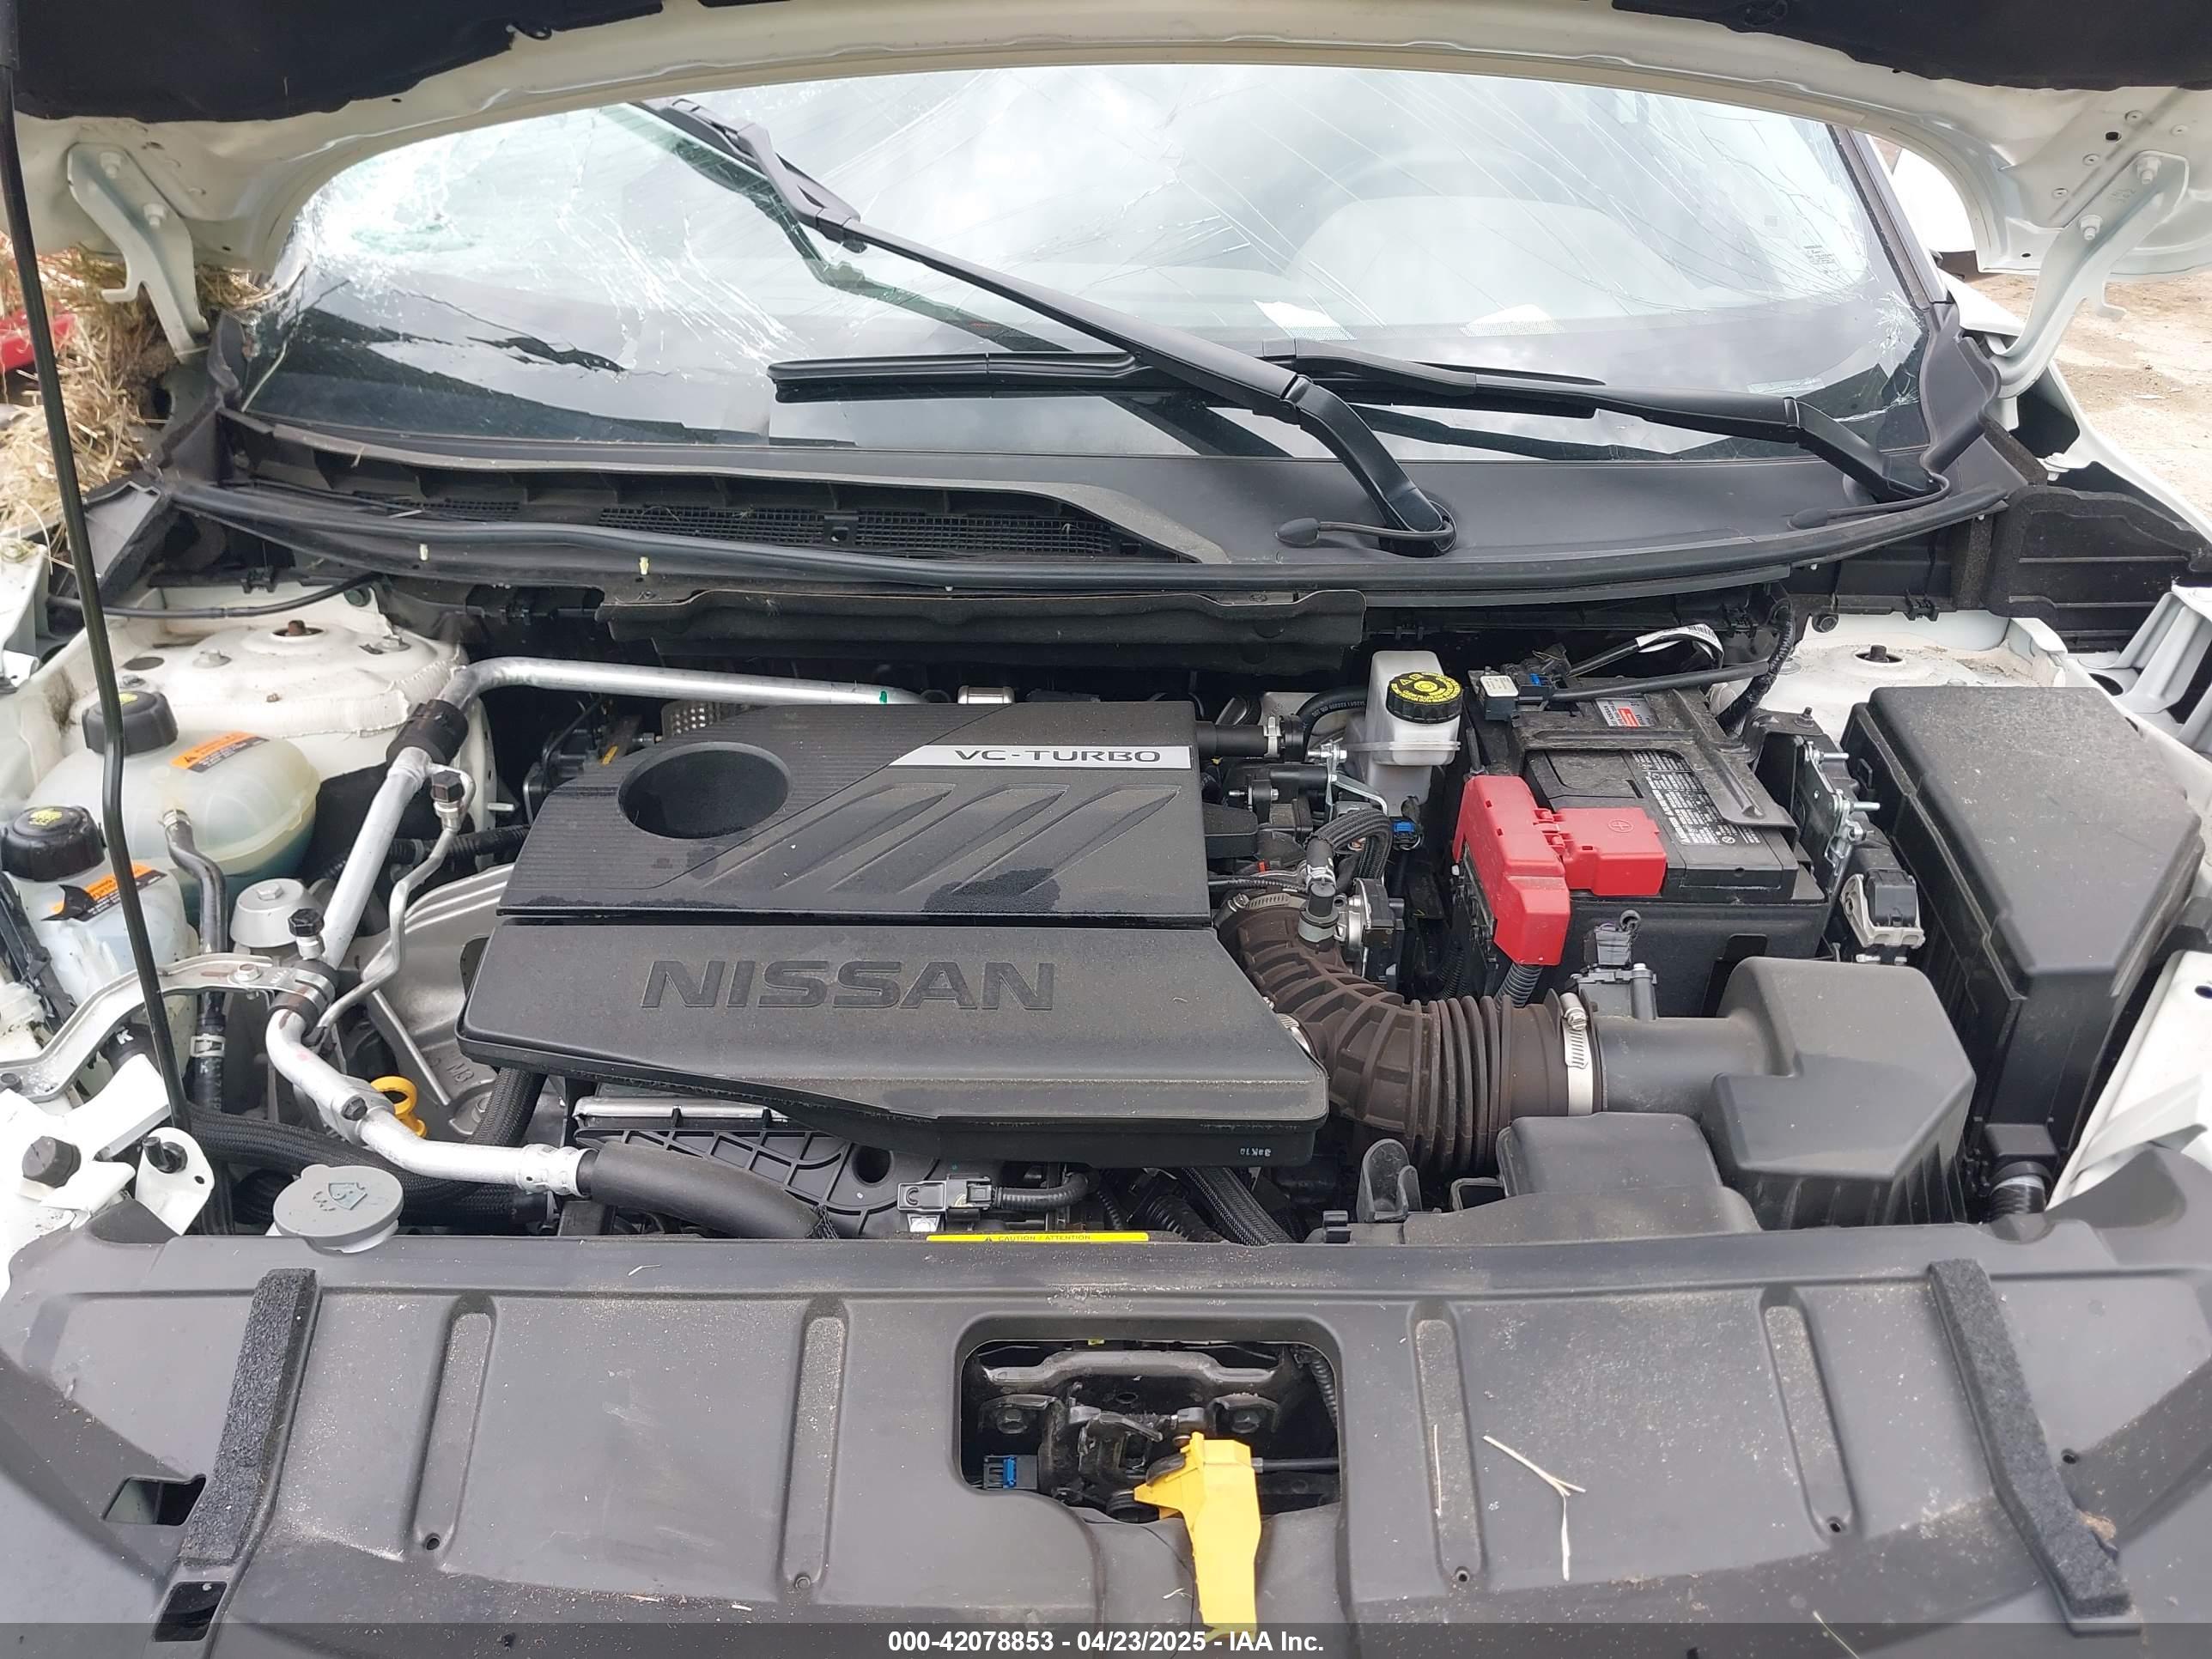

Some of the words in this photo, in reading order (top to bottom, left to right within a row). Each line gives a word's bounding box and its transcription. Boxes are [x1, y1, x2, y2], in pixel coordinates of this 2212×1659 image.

[953, 748, 1162, 763] VC-TURBO
[642, 960, 1054, 1011] NISSAN
[115, 1028, 134, 1045] K
[447, 1062, 475, 1083] M3
